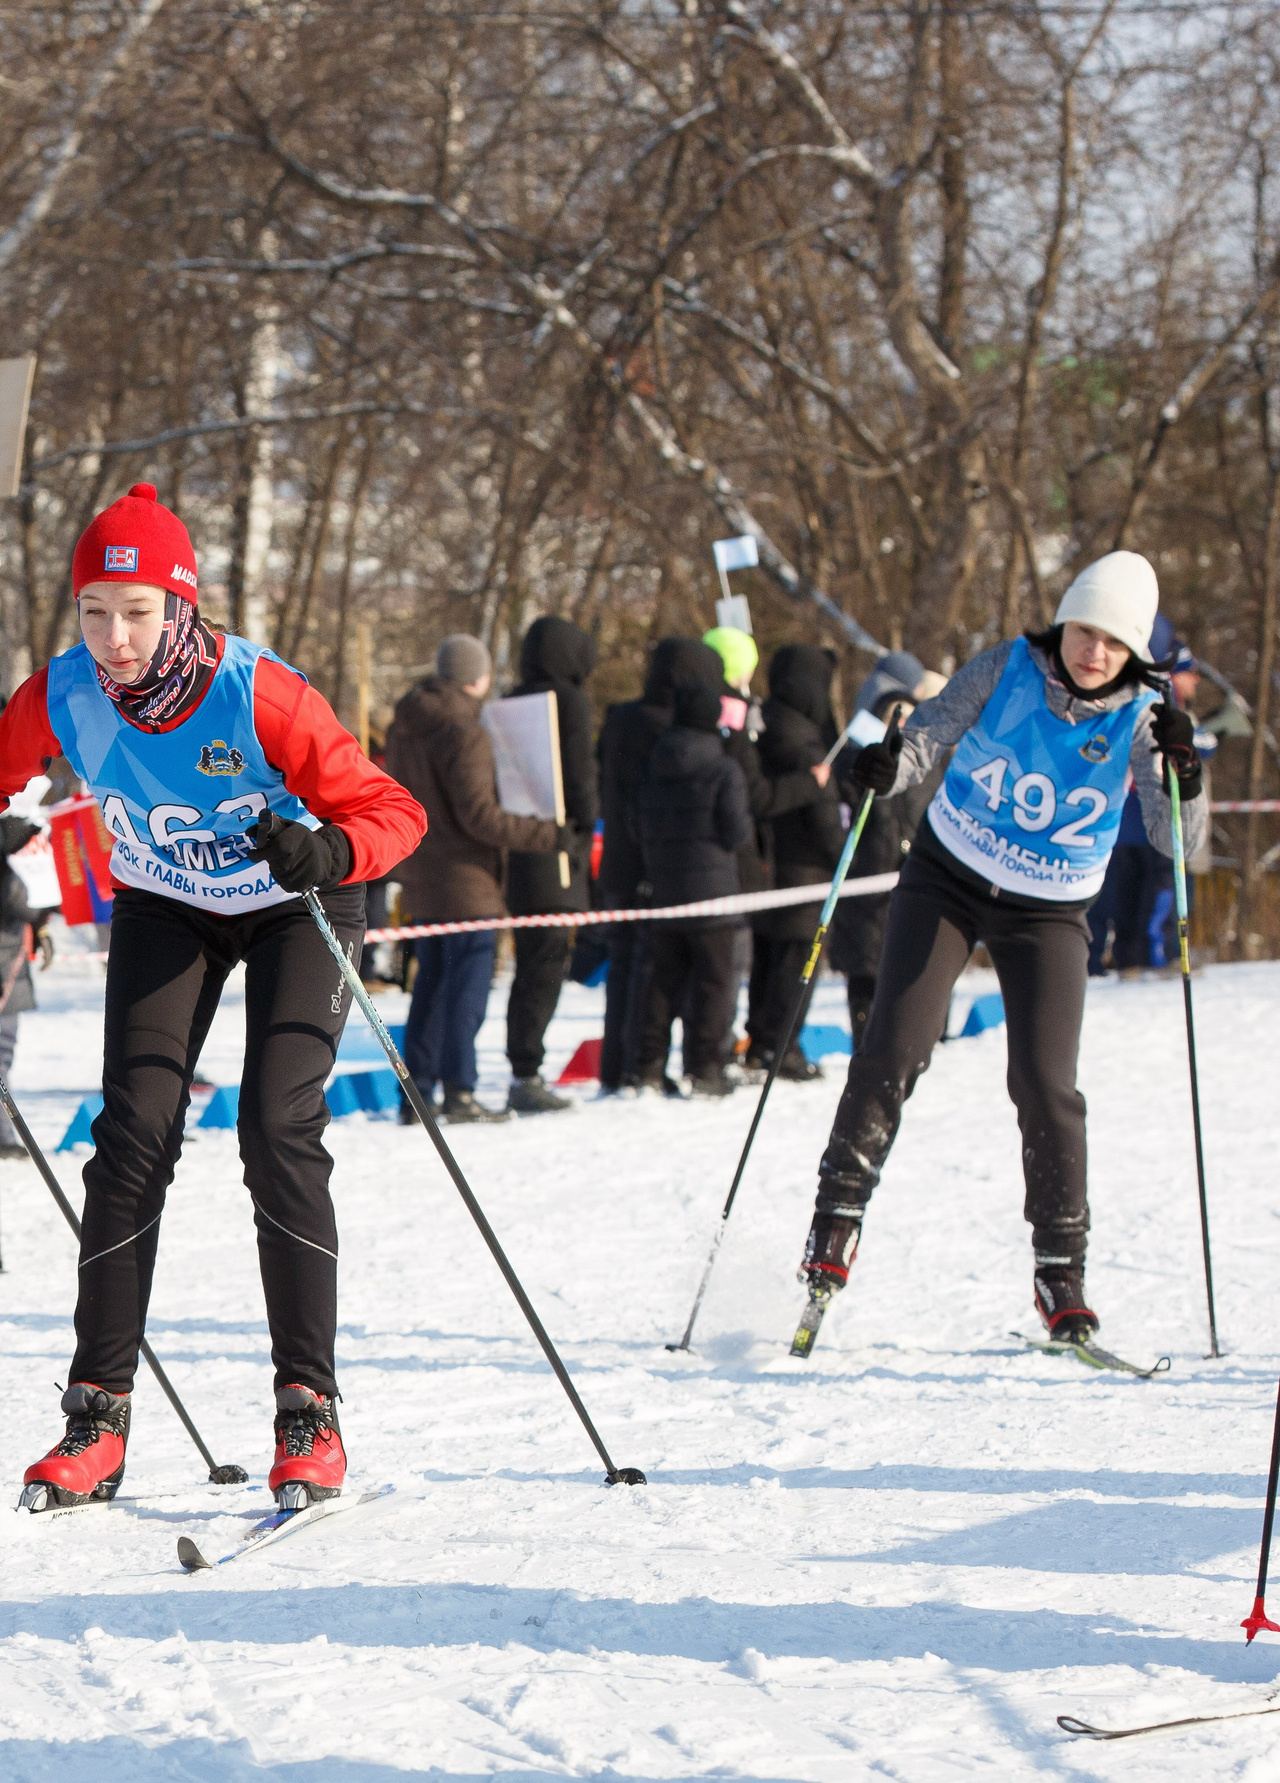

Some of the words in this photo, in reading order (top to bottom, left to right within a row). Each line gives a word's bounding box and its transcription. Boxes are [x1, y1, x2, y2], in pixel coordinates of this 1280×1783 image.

[970, 756, 1109, 848] 492
[118, 839, 141, 870] БОК
[145, 860, 196, 896] ГЛАВЫ
